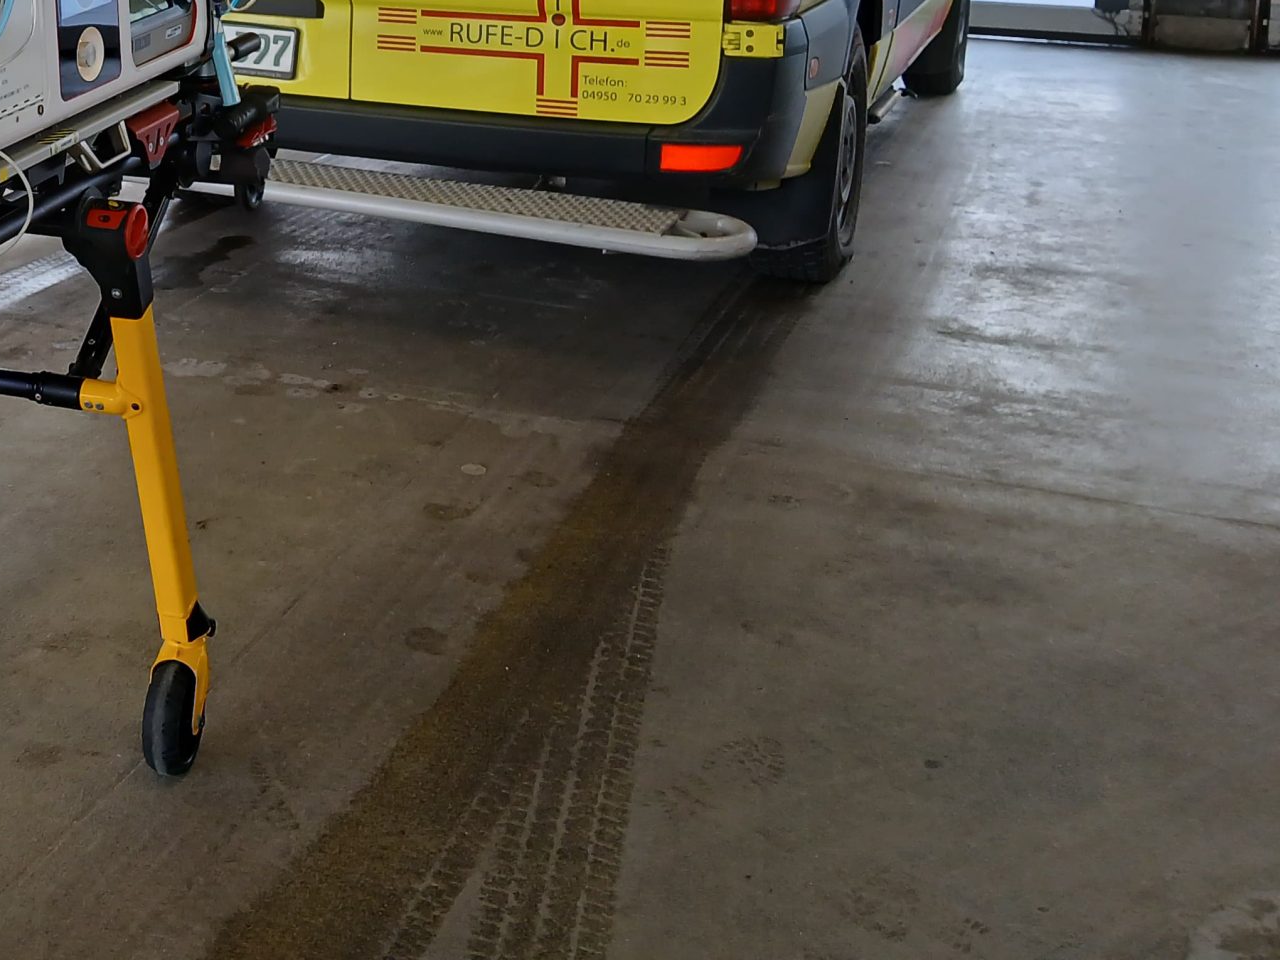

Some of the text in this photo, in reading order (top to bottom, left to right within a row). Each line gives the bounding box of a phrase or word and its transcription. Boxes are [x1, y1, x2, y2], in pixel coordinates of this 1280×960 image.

[583, 74, 628, 88] Telefon:
[582, 89, 687, 106] 04950 70 29 99 3
